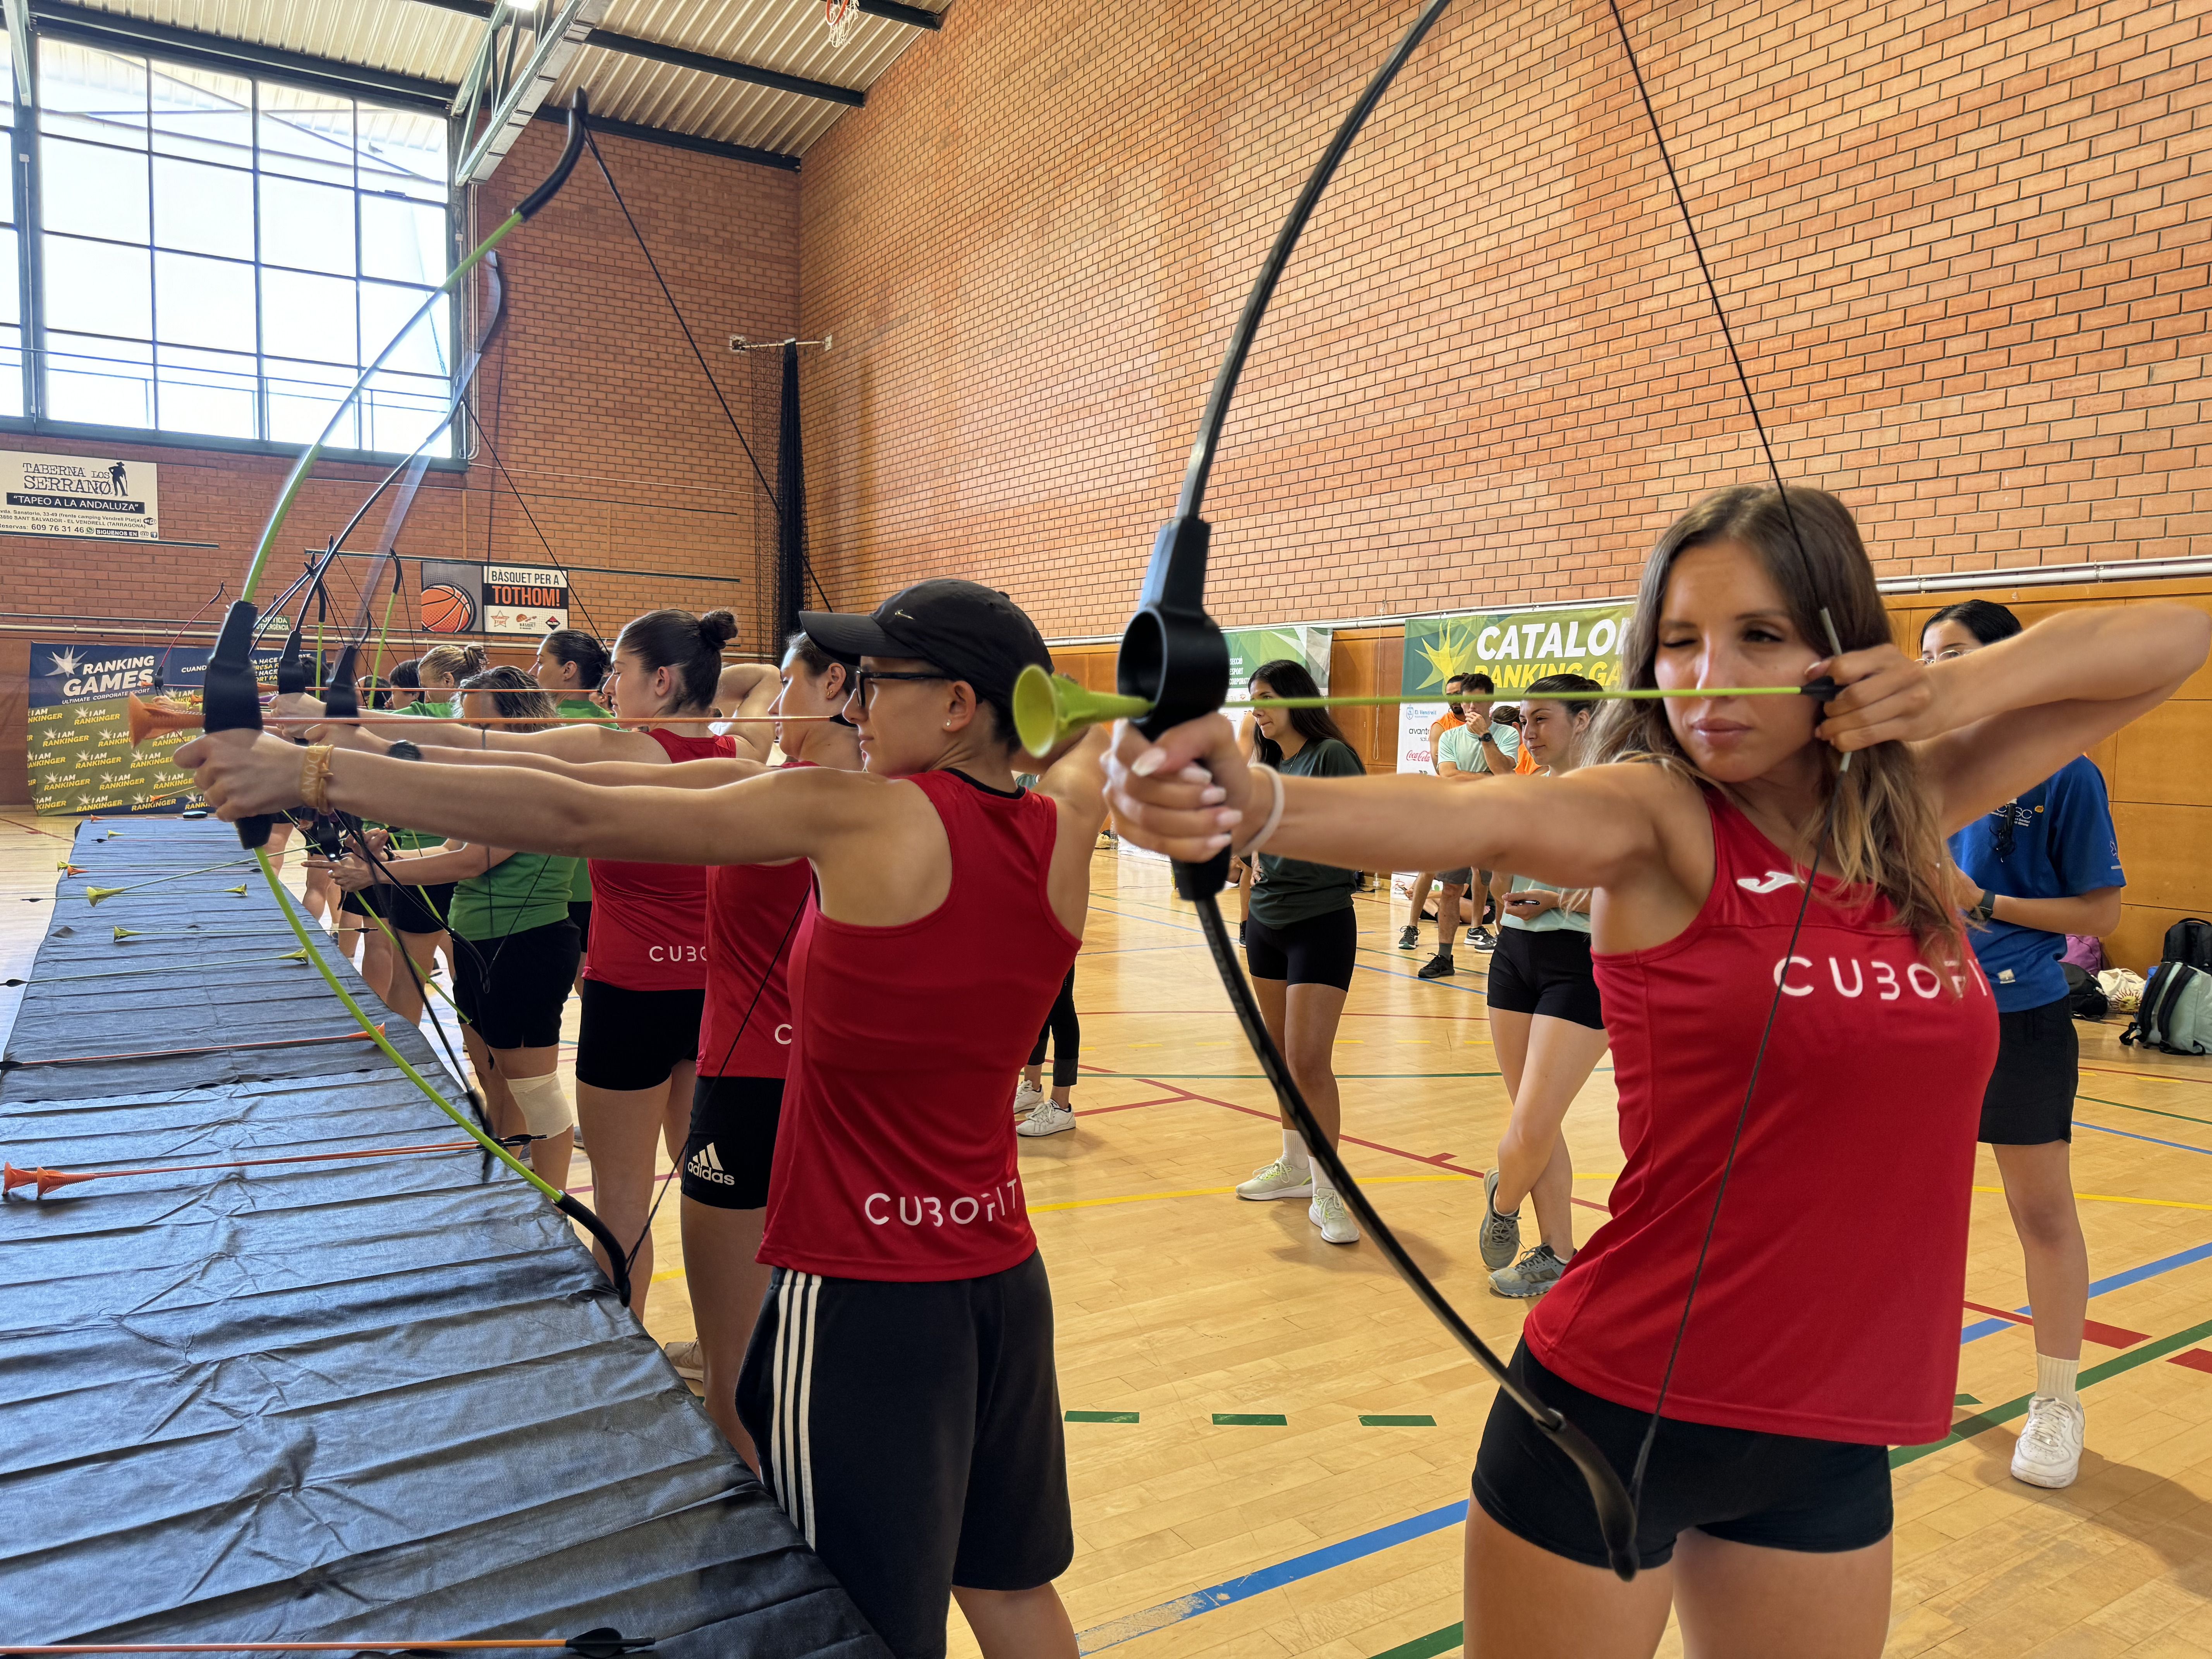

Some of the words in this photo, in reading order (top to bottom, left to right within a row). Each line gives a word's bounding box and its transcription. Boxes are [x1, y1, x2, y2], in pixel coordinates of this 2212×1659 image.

[23, 463, 86, 477] TABERNA
[91, 470, 110, 479] LOS
[54, 498, 62, 506] A
[64, 498, 77, 507] LA
[492, 569, 532, 584] BÀSQUET
[535, 574, 551, 584] PER
[554, 574, 559, 585] A
[492, 585, 560, 607] TOTHOM!
[83, 655, 155, 675] RANKING
[1230, 656, 1243, 665] SECCIÓ
[63, 669, 154, 696] GAMES
[93, 691, 129, 701] CORPORATE
[28, 713, 63, 723] NKINGER
[74, 713, 120, 725] RANKINGER
[43, 735, 89, 747] RANKINGER
[98, 737, 132, 747] RANKING
[27, 757, 66, 769] ANKINGER
[76, 757, 122, 769] RANKINGER
[44, 778, 90, 791] RANKINGER
[99, 778, 145, 790] RANKINGER
[153, 778, 194, 790] RANKINGE
[36, 800, 67, 810] KINGER
[76, 800, 123, 812] RANKINGER
[1773, 956, 1987, 1000] CUBOFI
[688, 1160, 735, 1185] adidas
[865, 1178, 1017, 1227] CUBOFIT
